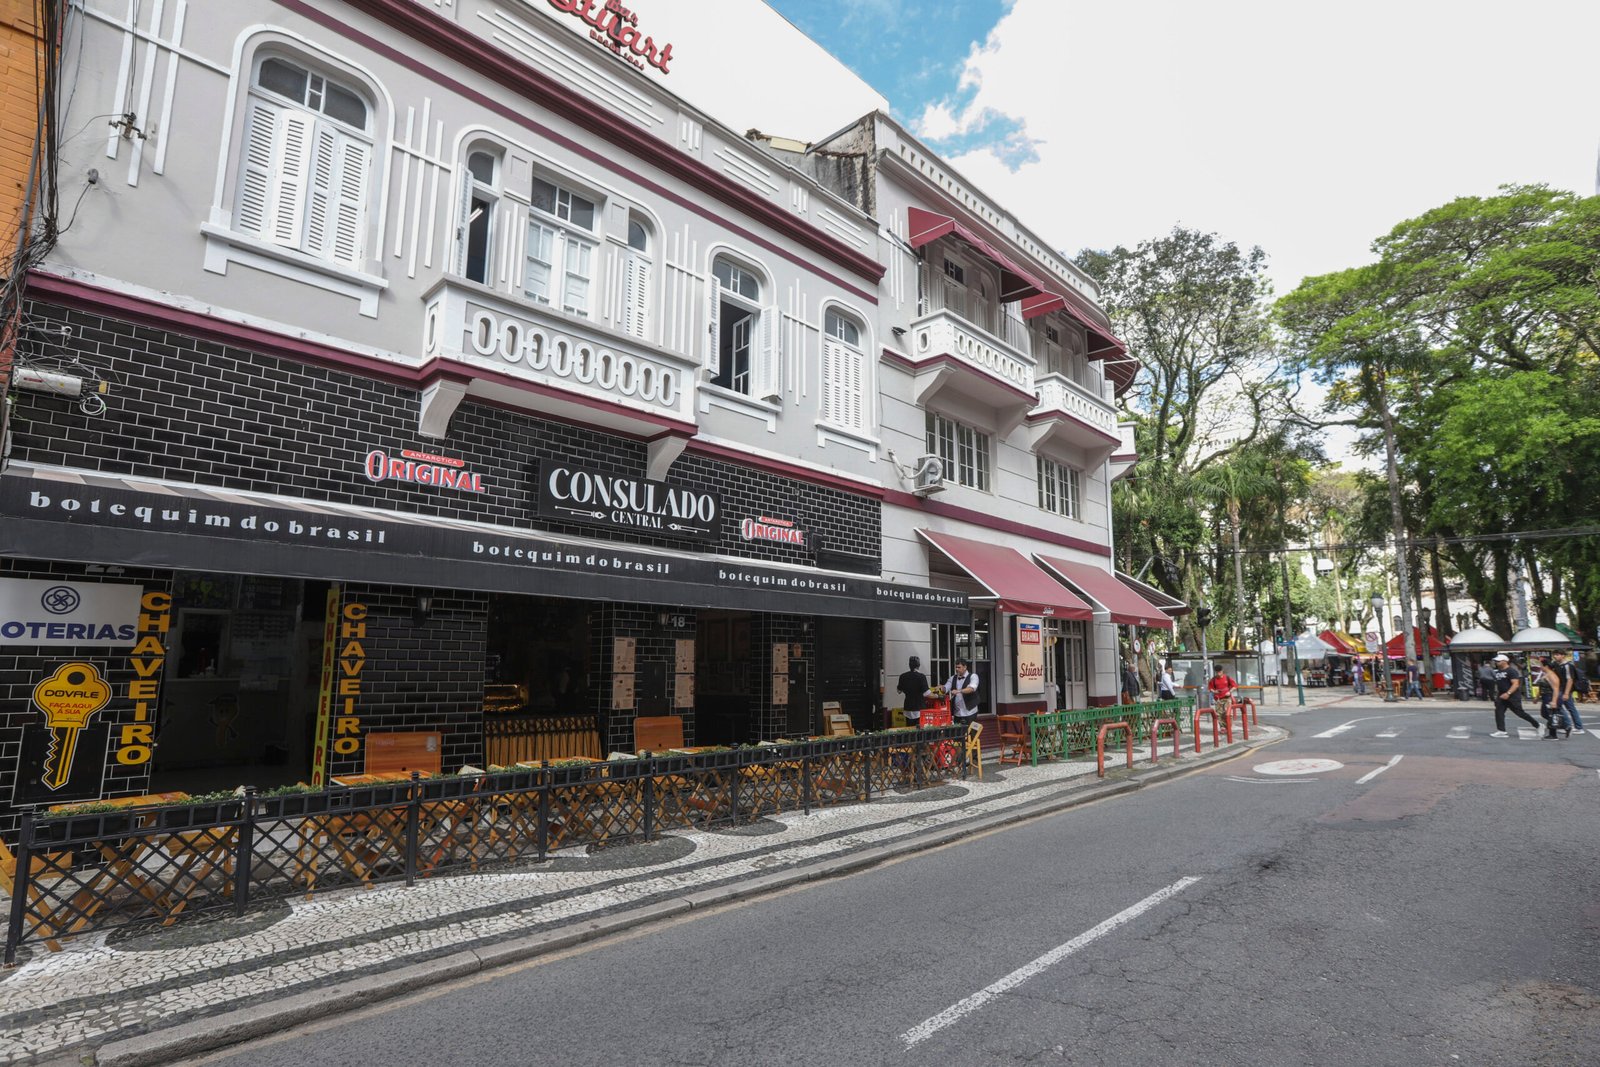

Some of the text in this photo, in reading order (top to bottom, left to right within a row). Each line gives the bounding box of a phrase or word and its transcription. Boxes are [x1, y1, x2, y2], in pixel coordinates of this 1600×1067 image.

[410, 452, 458, 465] ANTARCTICA
[365, 449, 486, 493] ORIGINAL
[549, 467, 715, 523] CONSULADO
[611, 510, 664, 529] CENTRAL
[741, 517, 804, 544] ORIGINAL
[671, 616, 685, 627] 18
[116, 592, 172, 765] CHAVEIRO
[334, 603, 367, 754] CHAVEIRO
[1019, 662, 1043, 678] Stuart
[44, 689, 99, 699] DOVALE
